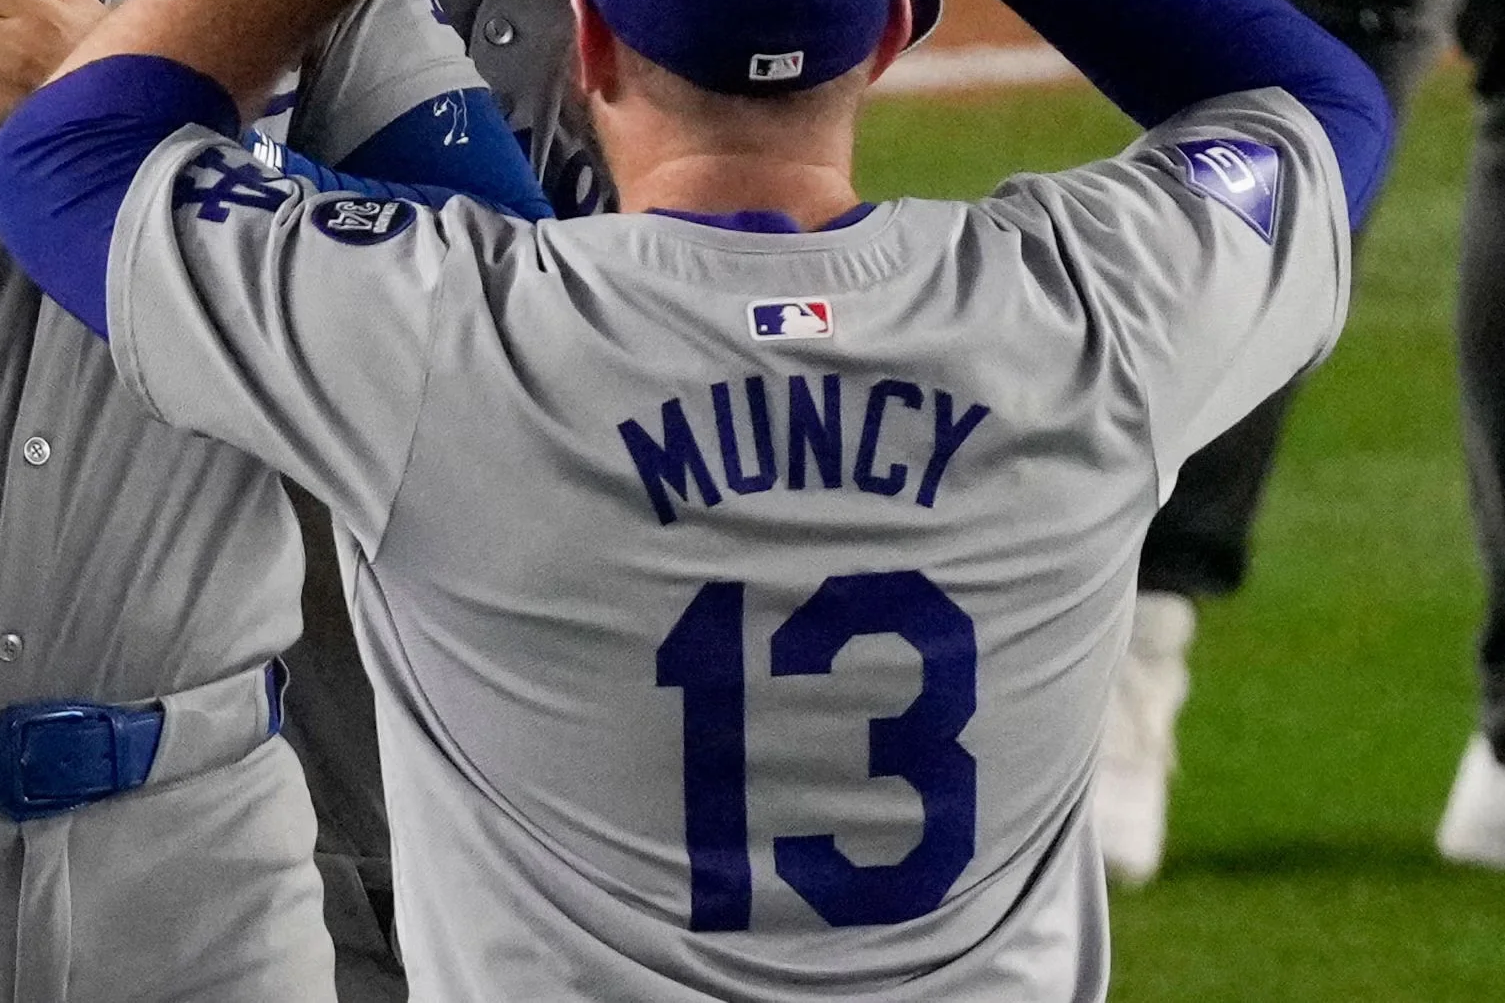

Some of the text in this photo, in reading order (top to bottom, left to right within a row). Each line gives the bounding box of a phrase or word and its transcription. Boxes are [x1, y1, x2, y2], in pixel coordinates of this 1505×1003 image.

[328, 200, 381, 231] 34
[617, 372, 991, 527] MUNCY
[655, 569, 978, 933] 13
